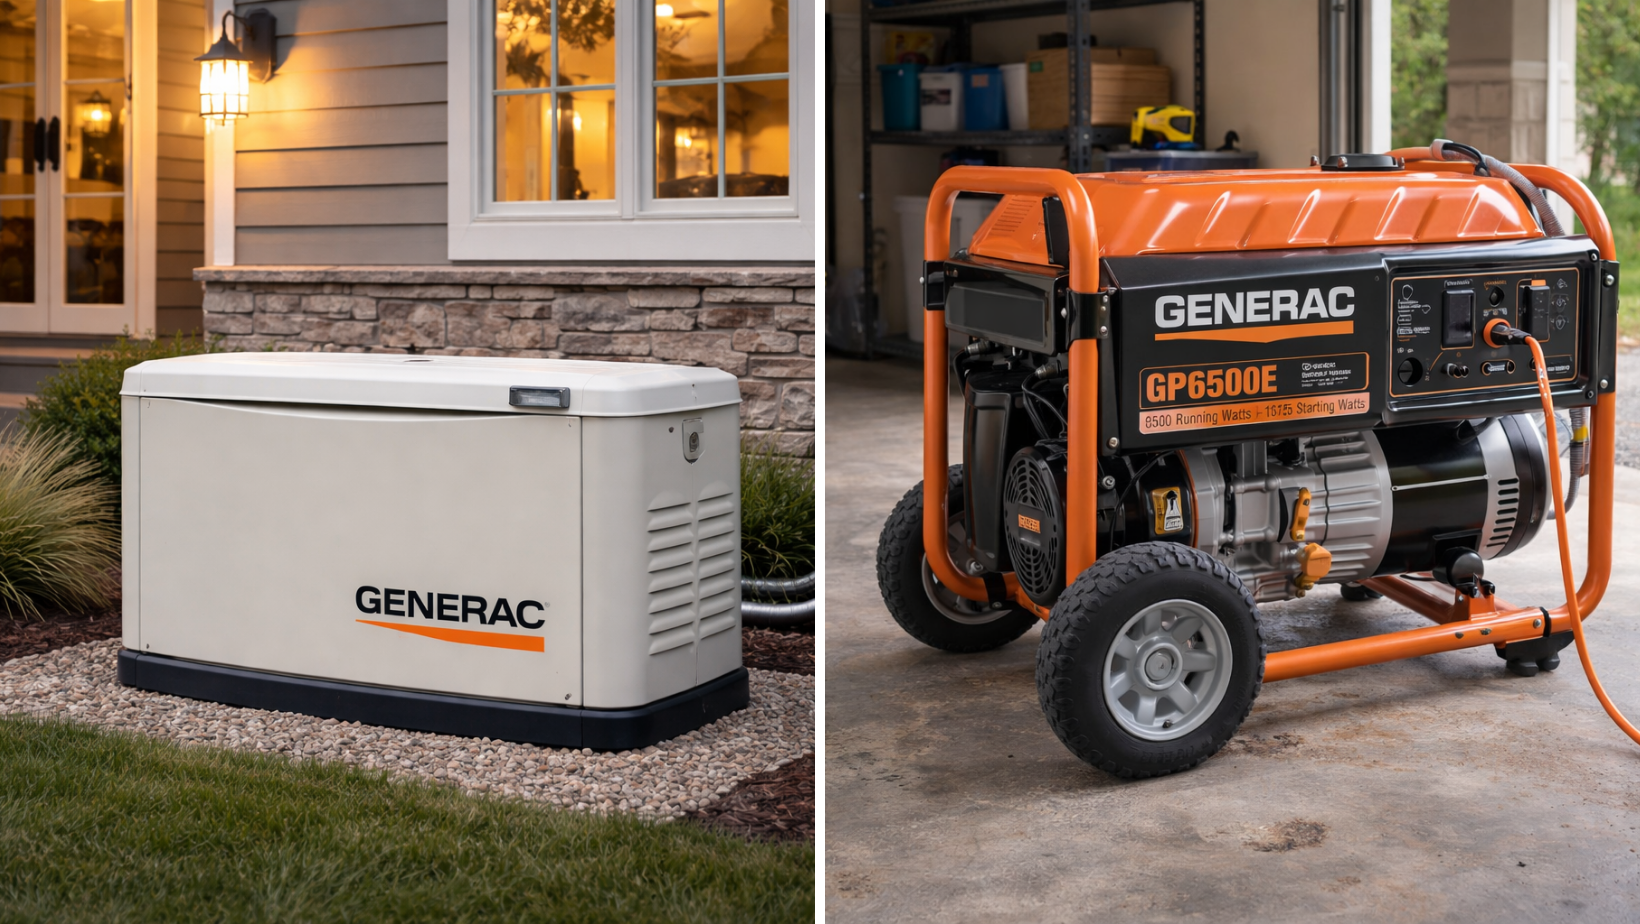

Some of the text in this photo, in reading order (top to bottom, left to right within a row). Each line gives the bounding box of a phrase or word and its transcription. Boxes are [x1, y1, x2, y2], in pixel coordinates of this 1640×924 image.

[1155, 286, 1355, 328] GENERAC
[1146, 364, 1277, 403] GP6500E
[1176, 411, 1218, 425] Running
[1222, 409, 1251, 421] Watts
[1296, 401, 1335, 414] Starting
[1338, 398, 1366, 410] Watts
[355, 585, 546, 630] GENERAC
